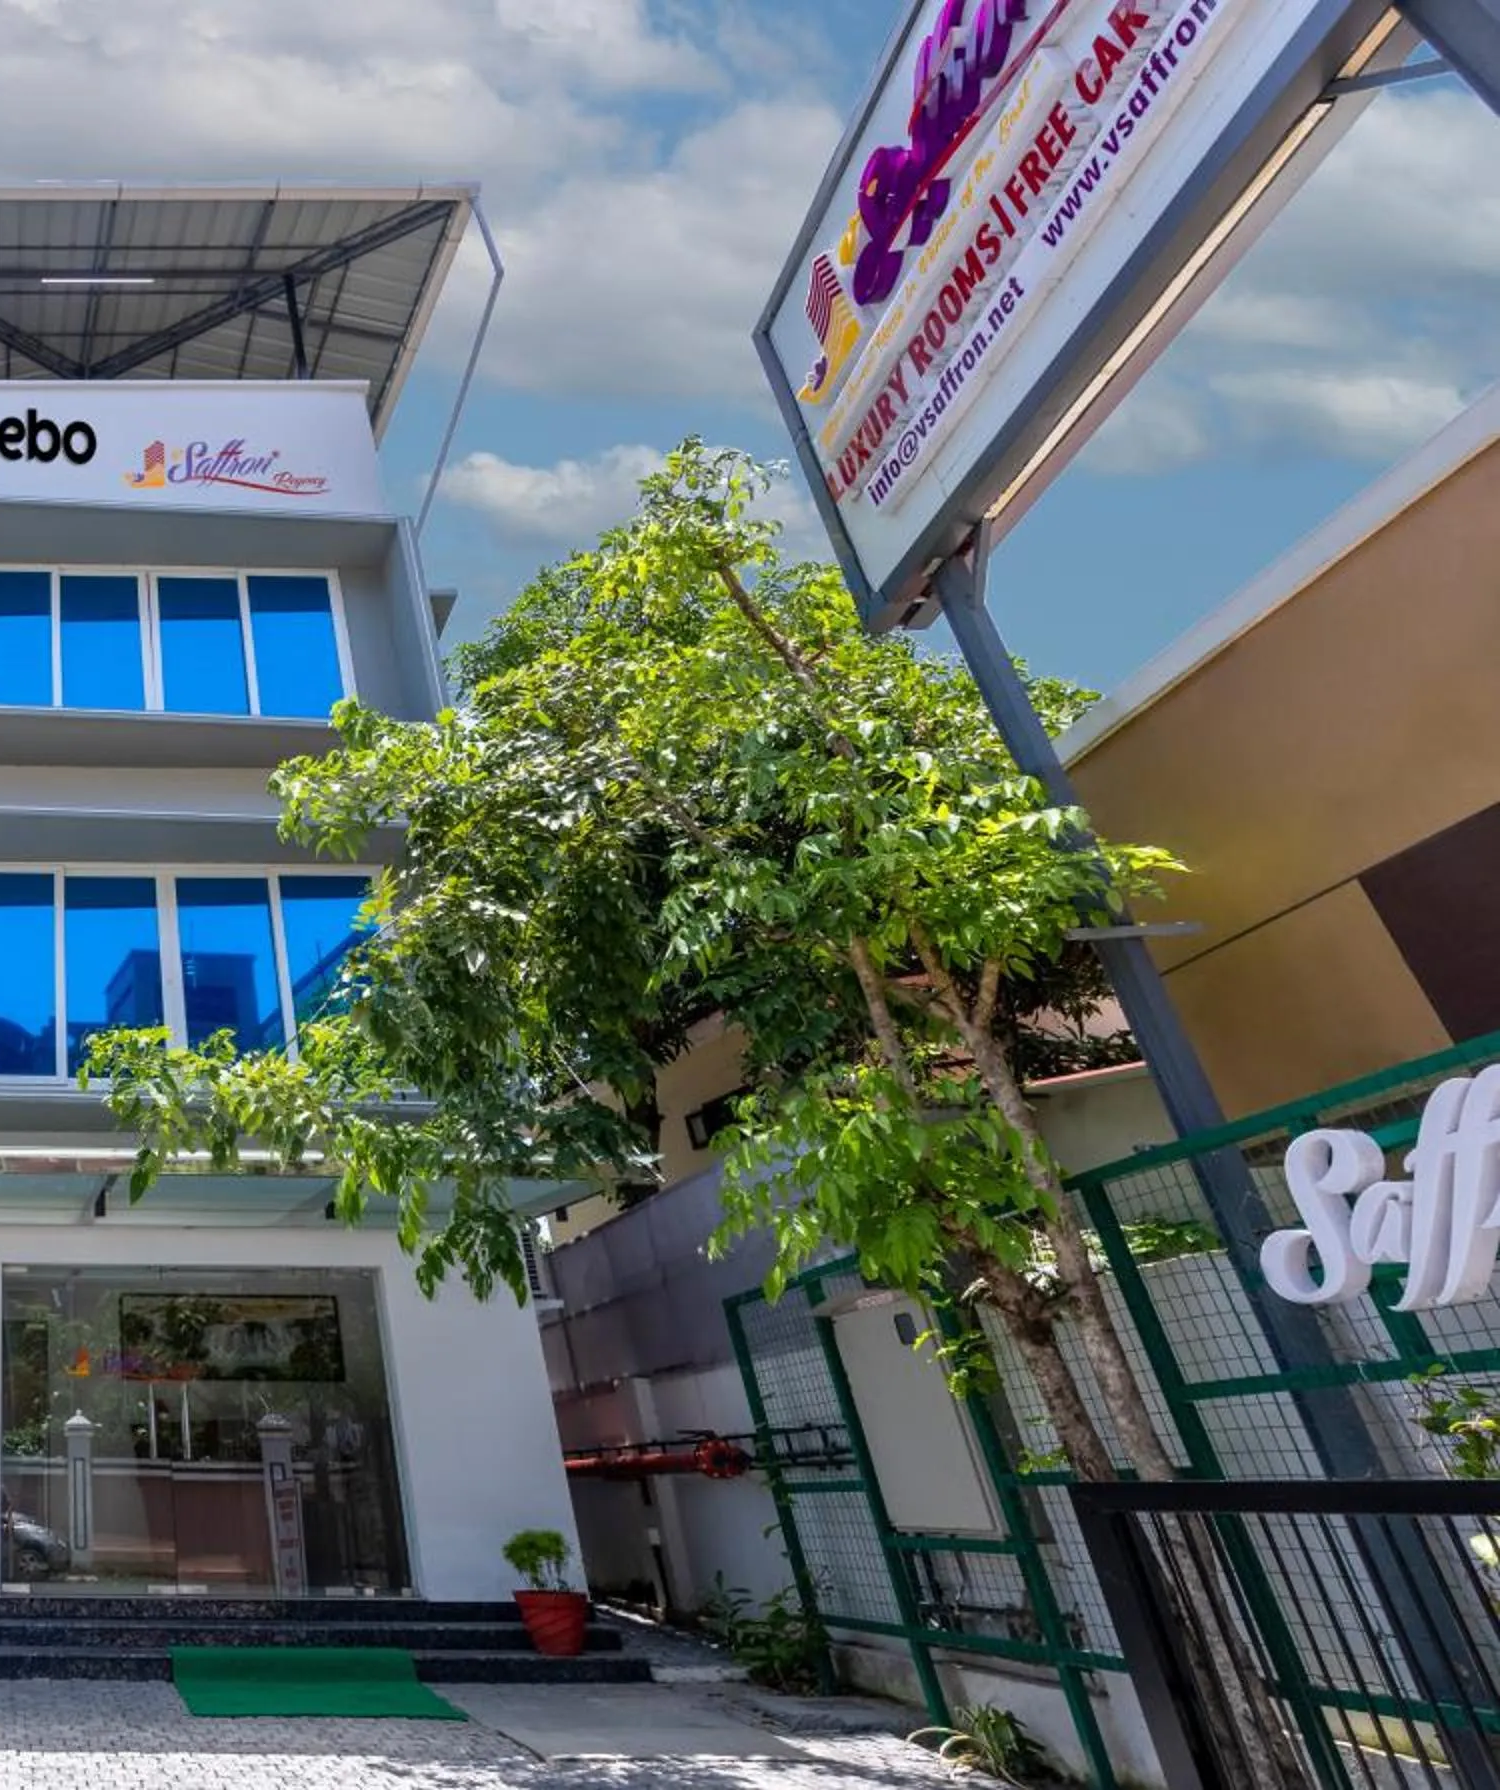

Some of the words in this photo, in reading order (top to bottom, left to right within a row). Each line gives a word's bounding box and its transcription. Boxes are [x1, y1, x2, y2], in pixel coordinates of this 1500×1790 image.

[167, 438, 280, 487] Saffron
[827, 359, 911, 503] LUXURY
[867, 275, 1026, 506] info@vsaffron.net
[1260, 1063, 1500, 1312] Saff
